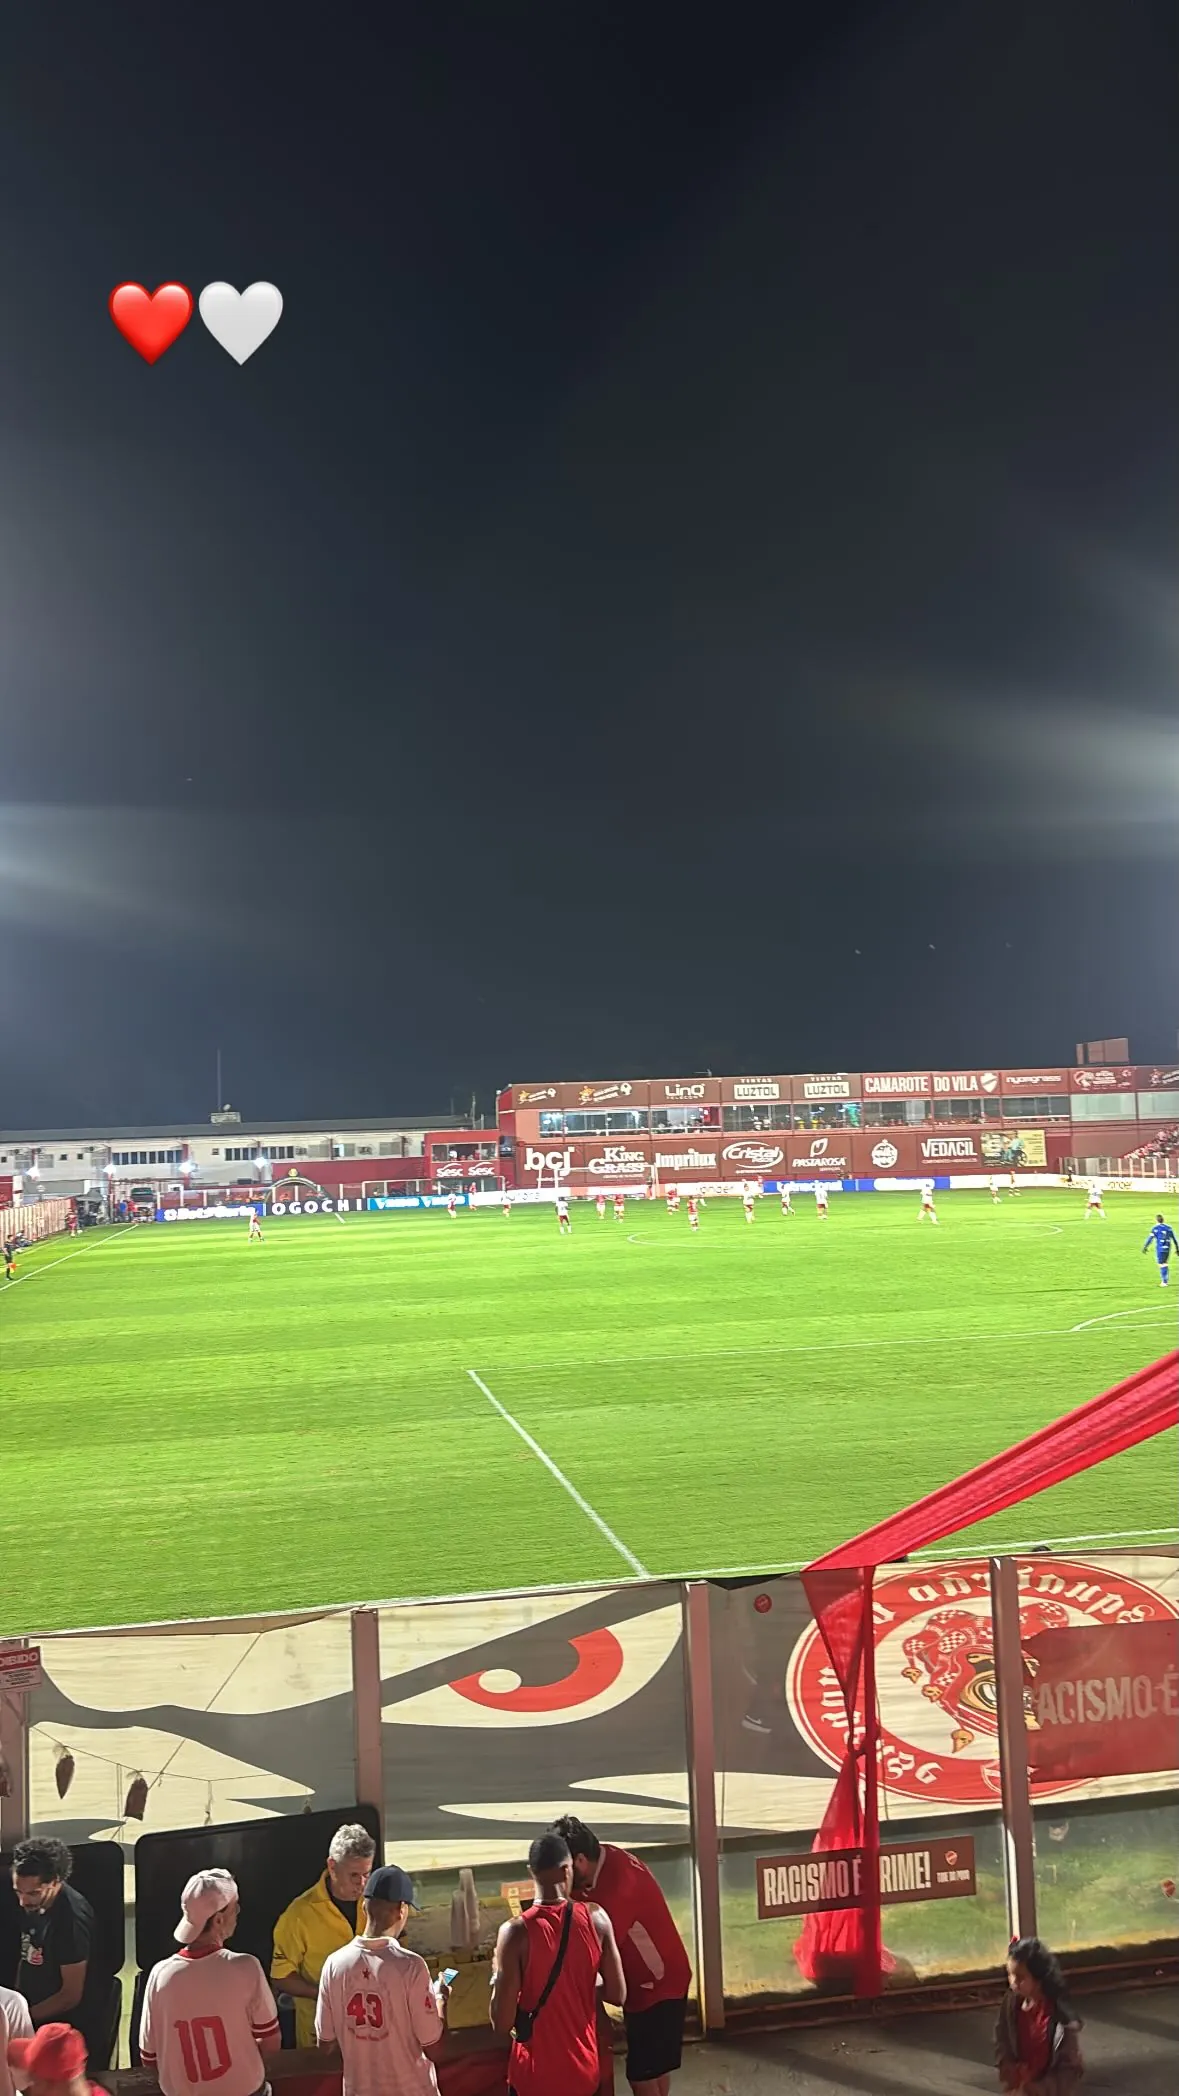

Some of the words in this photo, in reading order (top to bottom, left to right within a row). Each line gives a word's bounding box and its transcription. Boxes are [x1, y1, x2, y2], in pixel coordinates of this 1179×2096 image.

[736, 1085, 776, 1097] LUZTOL
[807, 1084, 847, 1095] LUZTOL
[865, 1076, 929, 1093] CAMAROTE
[933, 1076, 950, 1092] DO
[952, 1075, 979, 1091] VILA
[728, 1146, 779, 1160] Cristal
[921, 1138, 977, 1157] VEDACIL
[436, 1165, 463, 1177] Sesc
[468, 1164, 495, 1176] Sesc
[271, 1198, 362, 1216] OGOCHI
[1036, 1675, 1153, 1725] ACISMO
[763, 1860, 850, 1907] RACISMO
[879, 1850, 931, 1894] RIME!
[346, 1992, 383, 2029] 43
[173, 2015, 233, 2084] 10
